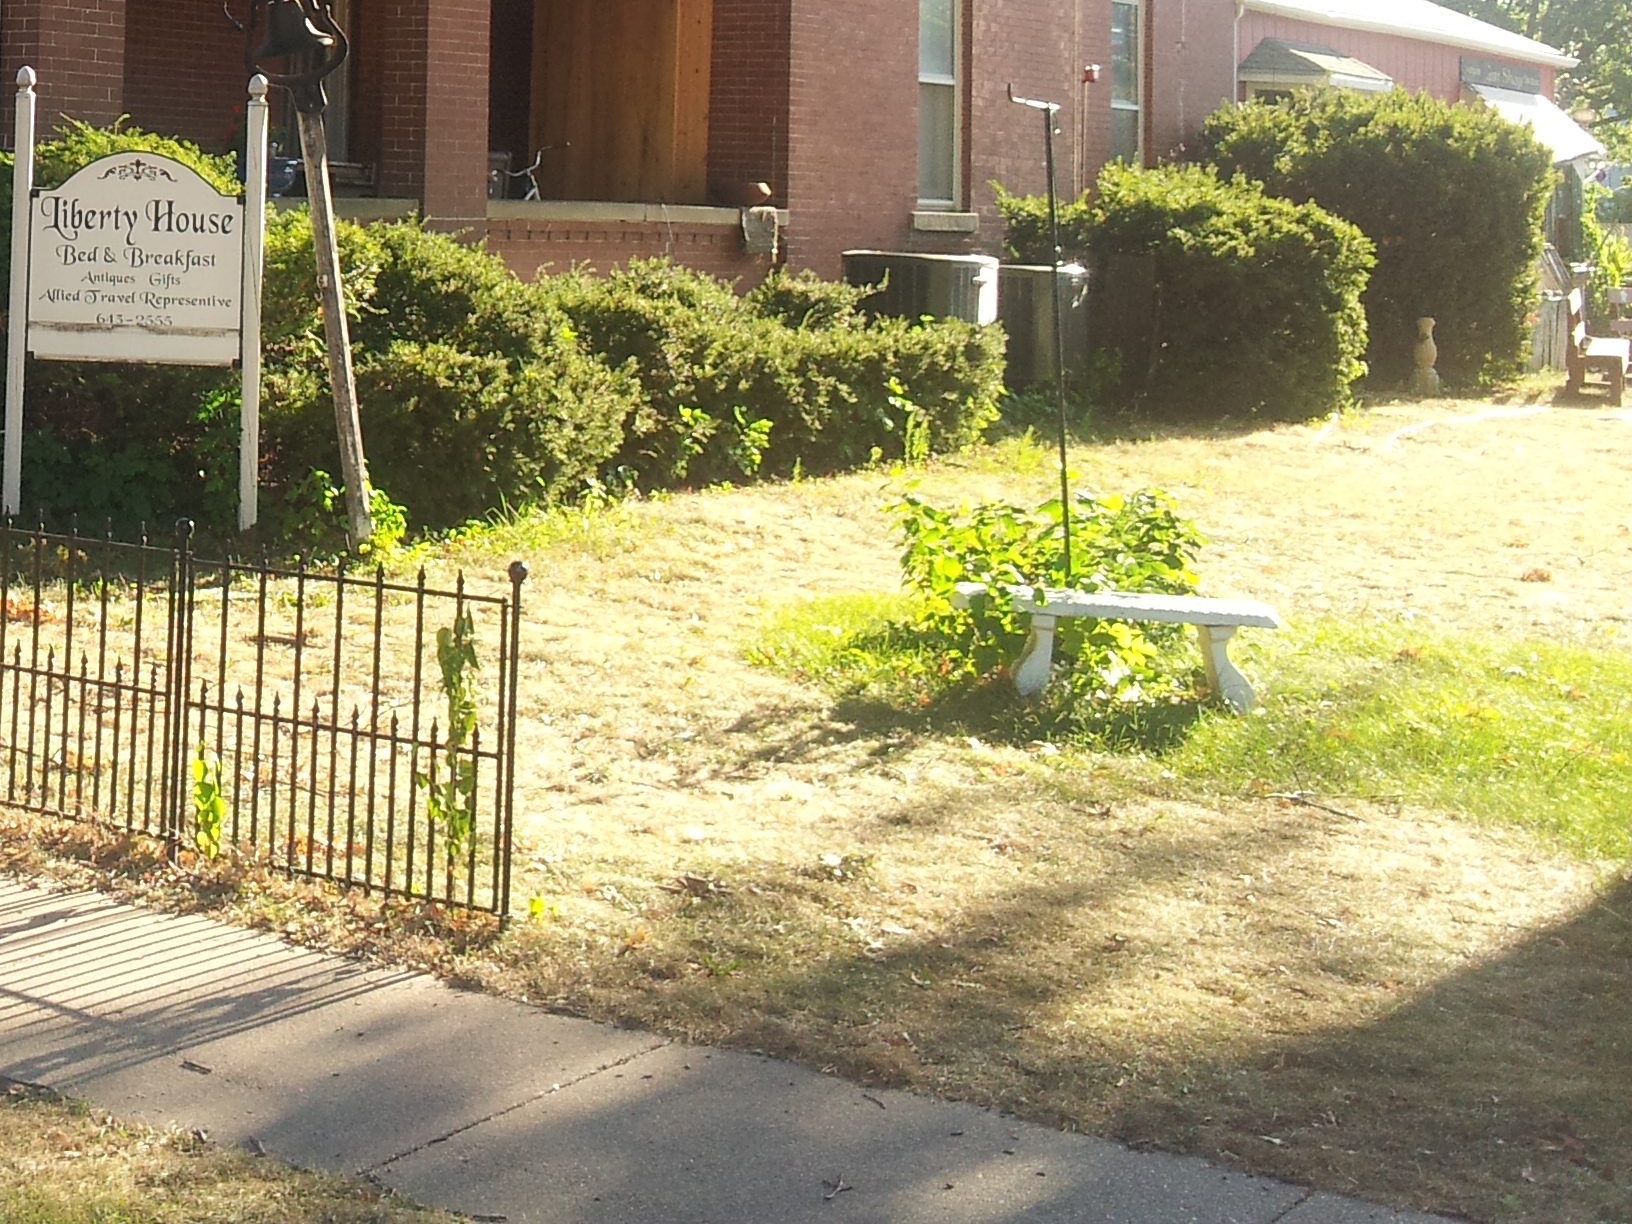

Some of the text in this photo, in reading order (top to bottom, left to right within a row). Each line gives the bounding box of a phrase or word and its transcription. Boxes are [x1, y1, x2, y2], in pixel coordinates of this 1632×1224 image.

[40, 196, 234, 246] Liberty House
[55, 244, 216, 273] Bed & Breakfast
[80, 270, 181, 290] Antiques Gifts
[38, 287, 233, 311] Allied Travel Representive
